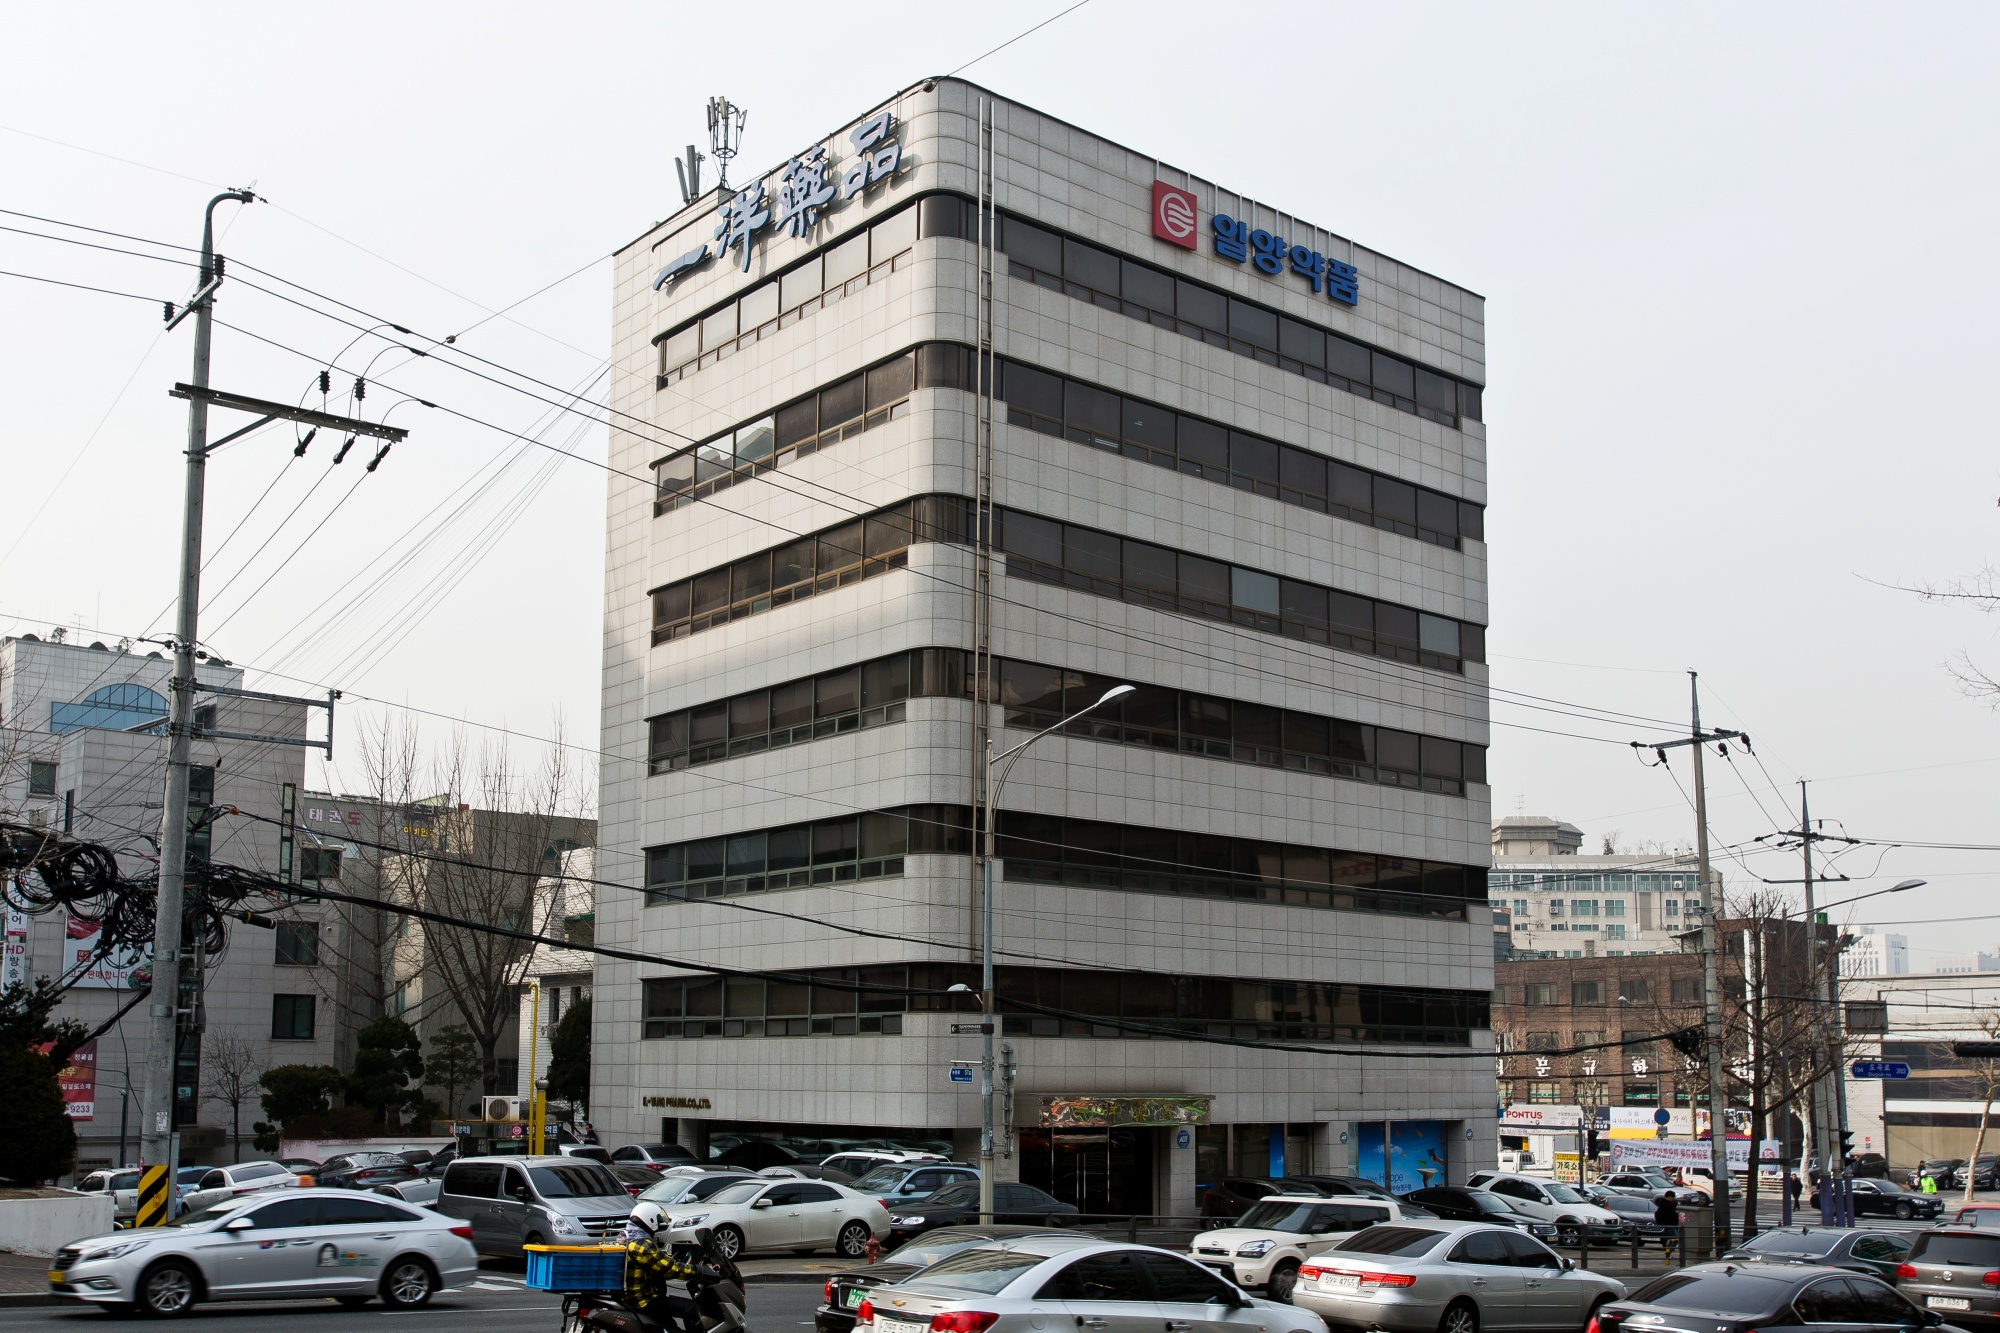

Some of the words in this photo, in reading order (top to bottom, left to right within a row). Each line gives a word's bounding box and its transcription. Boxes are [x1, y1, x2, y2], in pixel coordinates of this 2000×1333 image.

[652, 111, 903, 291] 一洋藥品
[1212, 213, 1359, 307] 일양약품
[308, 808, 361, 826] 태권도
[6, 945, 25, 955] HD
[1869, 1063, 1891, 1071] 도곡로
[1505, 1110, 1543, 1119] PONTUS
[1556, 1161, 1581, 1171] 가죽소
